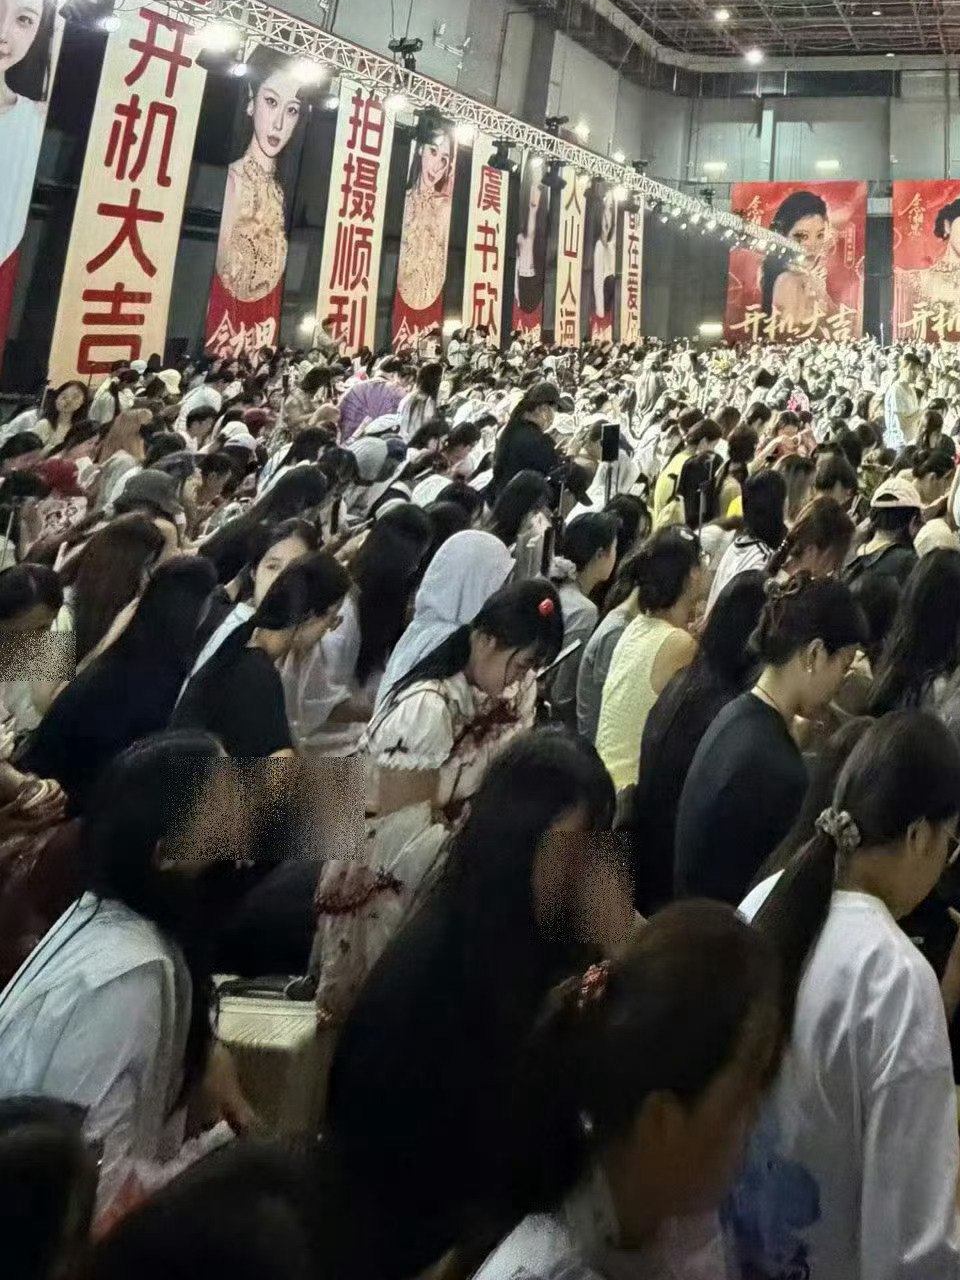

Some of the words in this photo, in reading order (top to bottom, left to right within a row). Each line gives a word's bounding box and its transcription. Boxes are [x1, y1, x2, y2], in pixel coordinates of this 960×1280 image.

[76, 6, 195, 376] 开机大吉
[329, 87, 386, 354] 拍摄顺利
[472, 165, 502, 336] 虞书欣
[729, 300, 857, 342] 开机大吉
